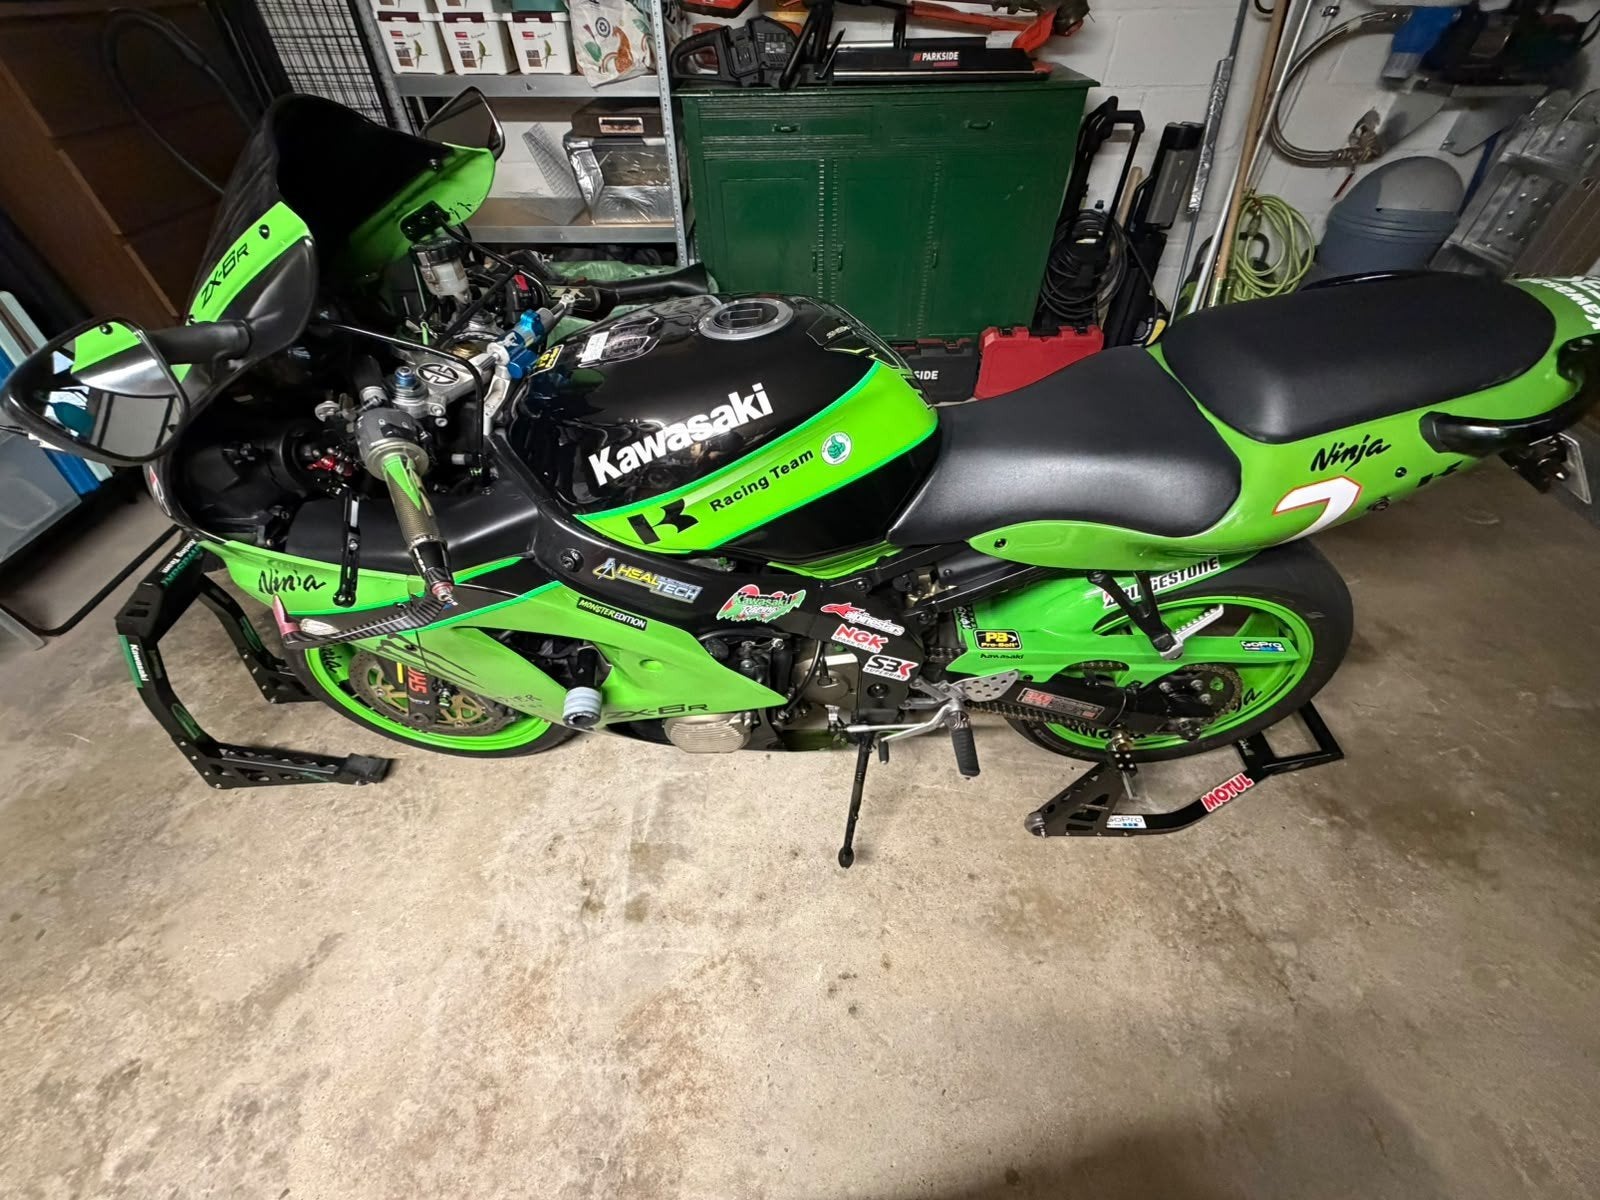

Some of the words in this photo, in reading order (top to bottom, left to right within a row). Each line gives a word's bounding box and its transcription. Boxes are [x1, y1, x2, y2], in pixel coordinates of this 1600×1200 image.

[922, 51, 959, 61] PARKSIDE
[200, 242, 250, 310] ZX-6R
[588, 382, 774, 487] Kawasaki
[1310, 434, 1392, 472] Ninja
[709, 476, 770, 513] Racing
[769, 449, 814, 480] Team
[175, 539, 197, 558] Racing
[161, 558, 181, 573] Team
[733, 591, 794, 608] Kawasaki
[845, 612, 904, 635] alpinestars
[836, 626, 888, 649] NGK
[985, 632, 1009, 643] PB
[129, 644, 150, 682] Kawasaki
[605, 703, 709, 719] ZX-6R
[1202, 772, 1254, 811] MOTUL
